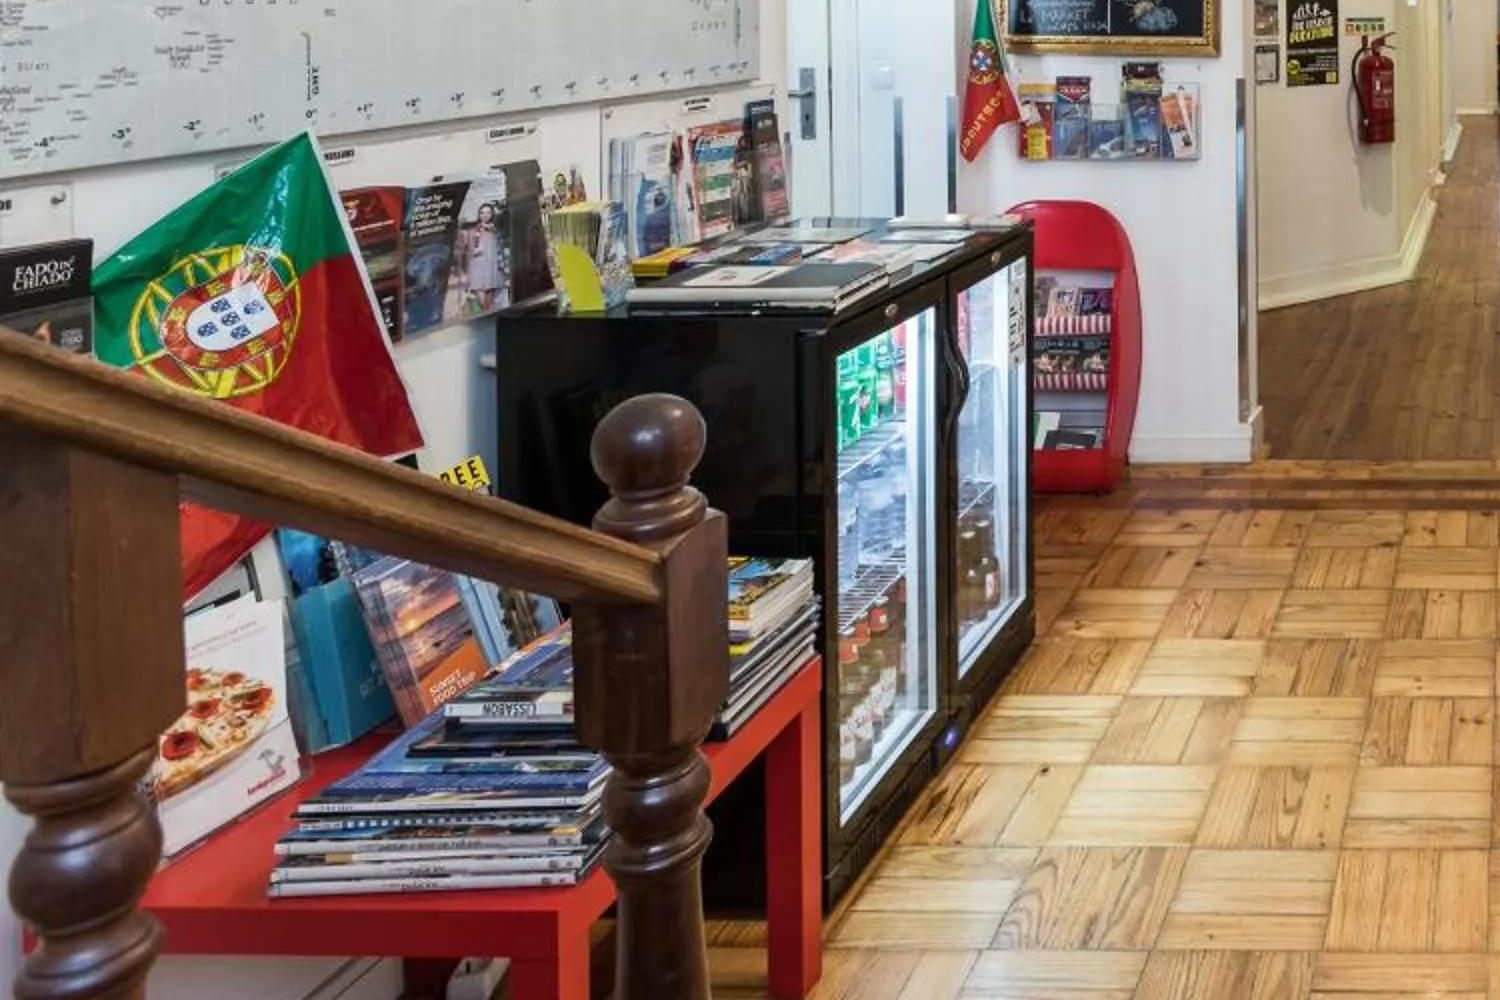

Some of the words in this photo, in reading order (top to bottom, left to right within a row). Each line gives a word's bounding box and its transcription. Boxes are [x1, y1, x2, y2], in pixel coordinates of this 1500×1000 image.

[311, 66, 321, 96] GMT
[12, 269, 71, 292] CHIADO
[15, 260, 59, 281] FADO
